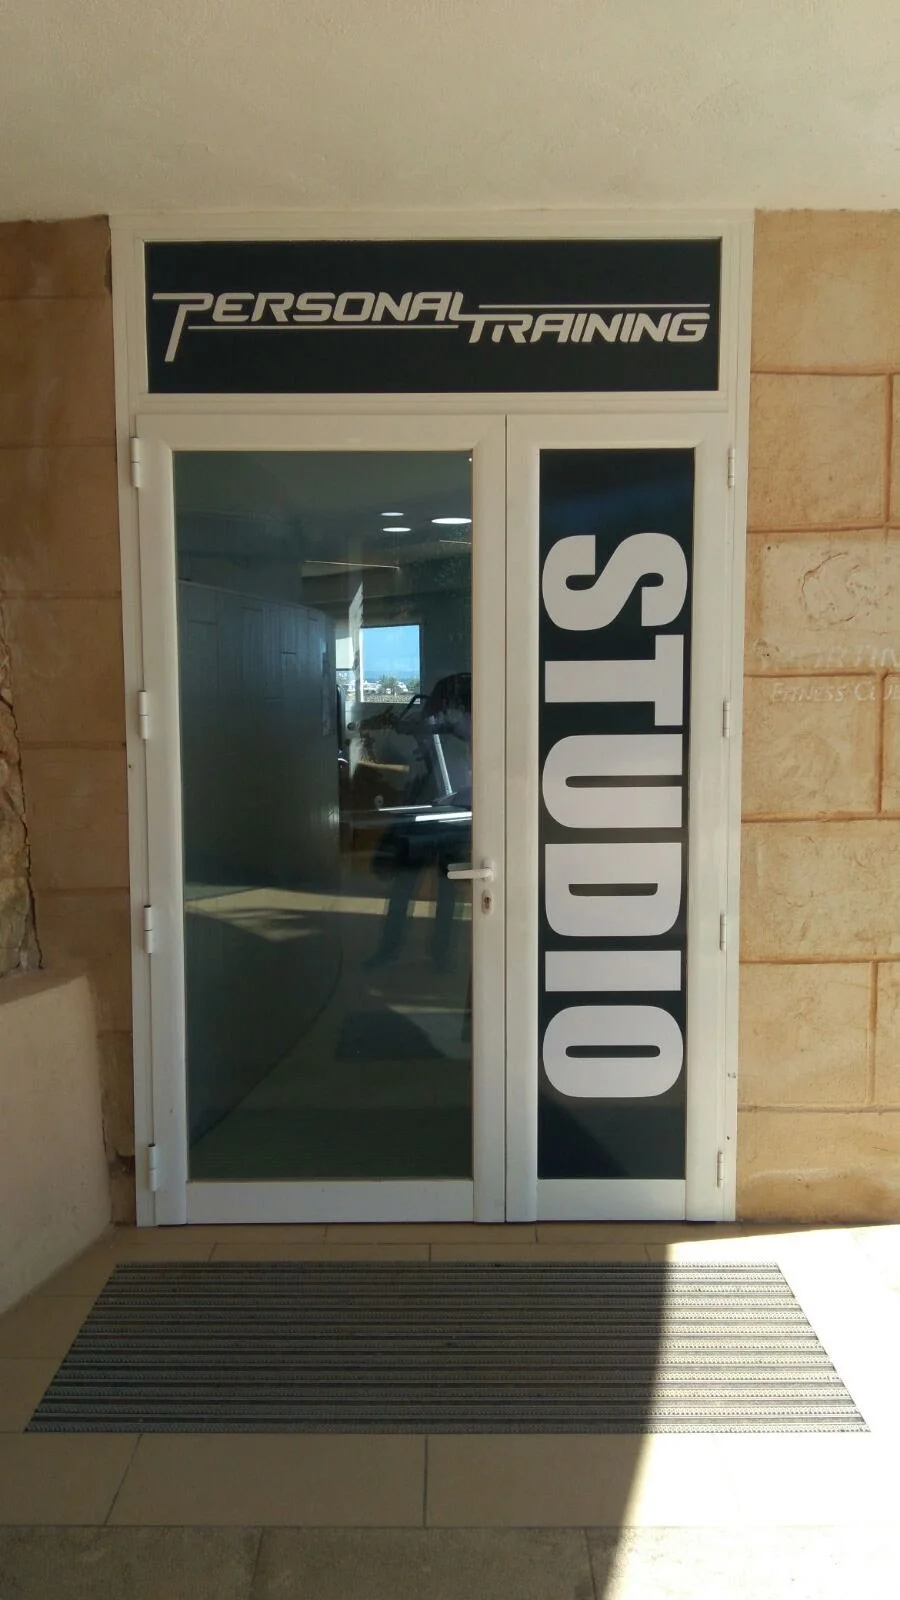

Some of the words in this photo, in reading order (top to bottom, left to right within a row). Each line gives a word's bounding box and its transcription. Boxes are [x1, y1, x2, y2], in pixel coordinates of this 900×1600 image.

[152, 292, 470, 362] PERSONAL
[462, 312, 710, 343] TRAINING
[542, 533, 688, 1099] STUDIO
